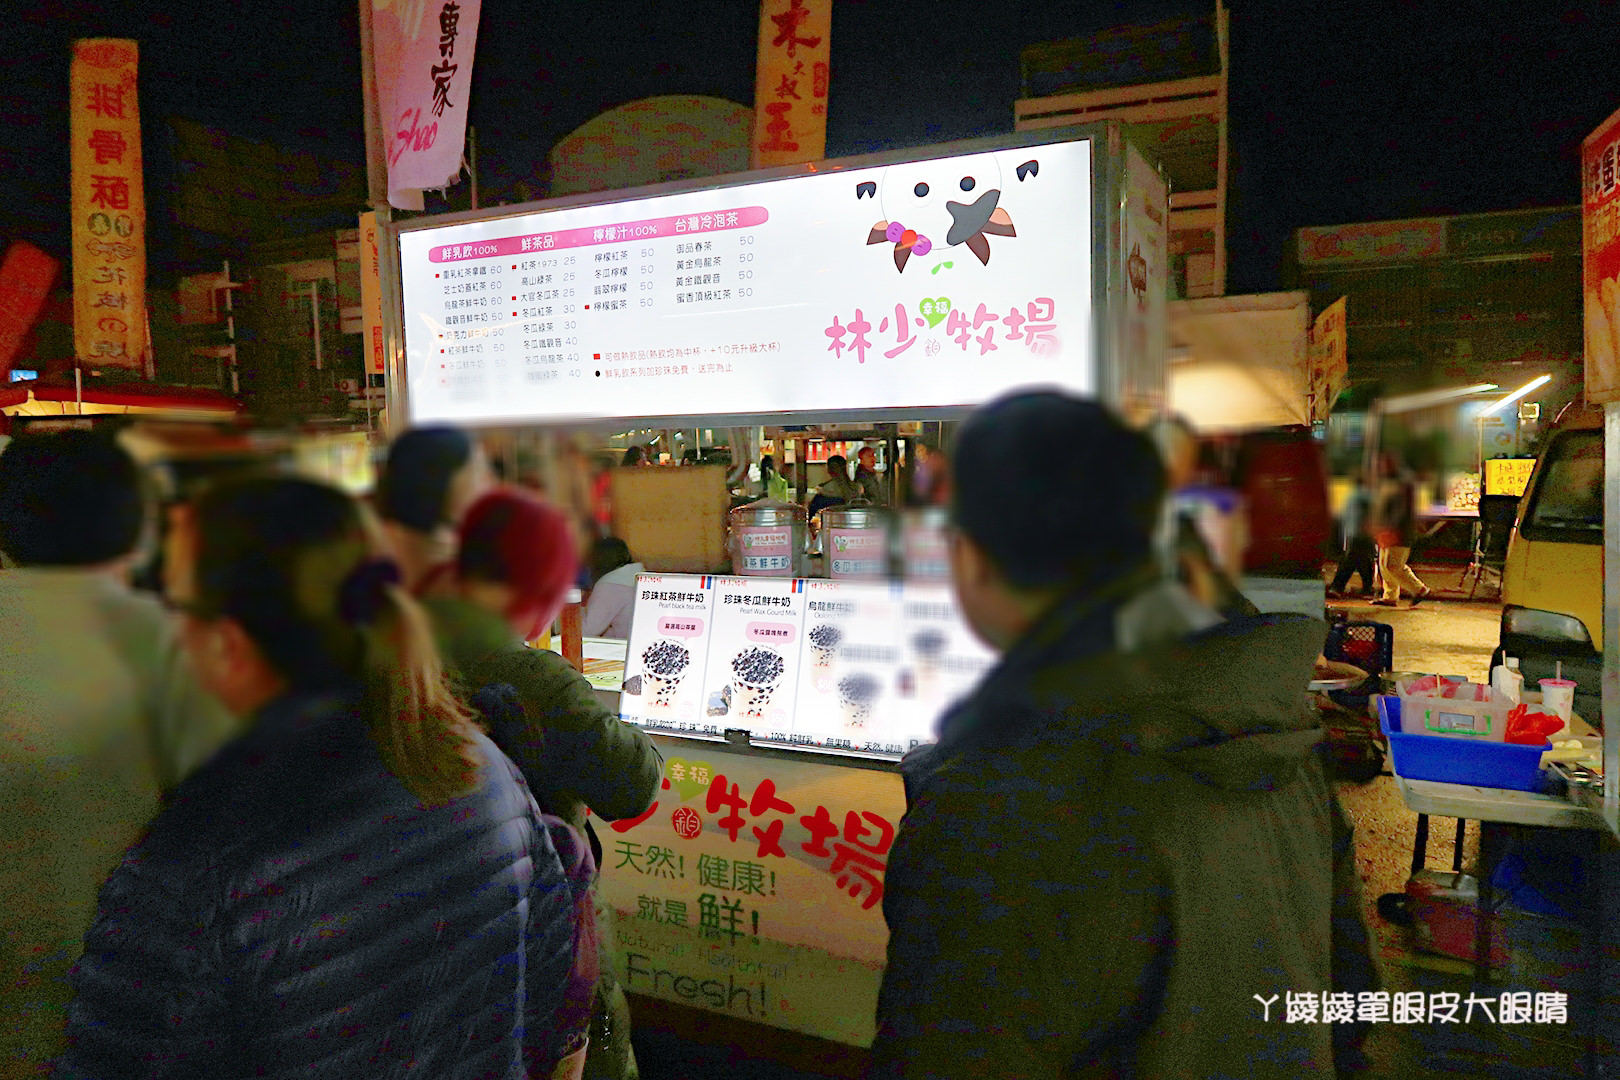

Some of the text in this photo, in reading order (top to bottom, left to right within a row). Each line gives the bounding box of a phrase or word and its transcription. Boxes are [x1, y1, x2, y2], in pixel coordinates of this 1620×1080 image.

[674, 211, 739, 233] 台灣冷泡茶
[593, 225, 658, 242] 檸檬汁100%
[521, 235, 555, 251] 鮮茶品
[441, 245, 498, 261] 鮮乳飲100%
[594, 250, 628, 262] 檸檬紅茶
[521, 259, 557, 270] 紅茶1973
[594, 266, 628, 279] 冬瓜檸檬
[522, 306, 553, 318] 冬瓜紅茶
[922, 302, 949, 316] 幸福
[642, 590, 704, 603] 珍珠紅茶鮮牛奶
[724, 594, 791, 607] 珍珠冬瓜鮮牛奶
[670, 762, 710, 785] 幸福
[705, 774, 895, 910] 牧場
[626, 951, 767, 1018] Fresh!
